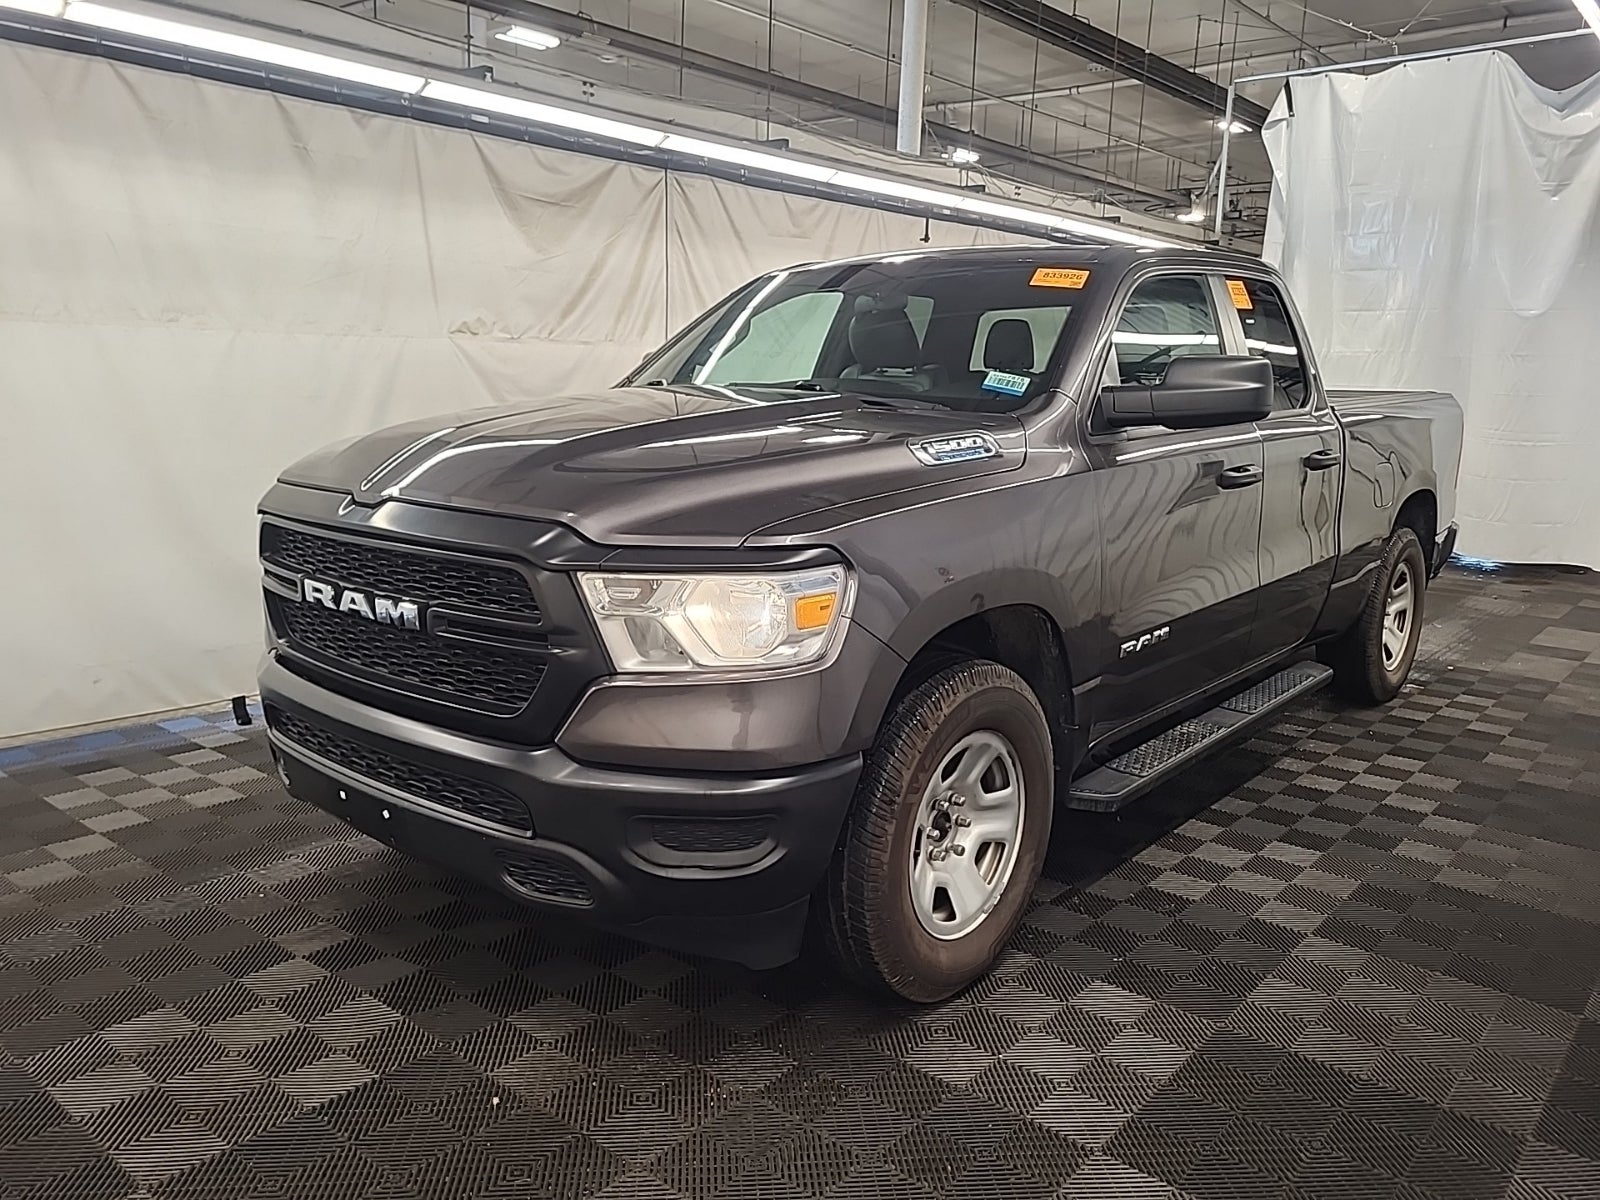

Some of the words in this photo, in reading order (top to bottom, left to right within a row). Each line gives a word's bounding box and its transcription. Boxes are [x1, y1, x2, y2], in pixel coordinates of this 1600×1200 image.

[922, 437, 984, 454] 1500
[304, 578, 419, 631] RAM
[1120, 626, 1170, 658] RAM
